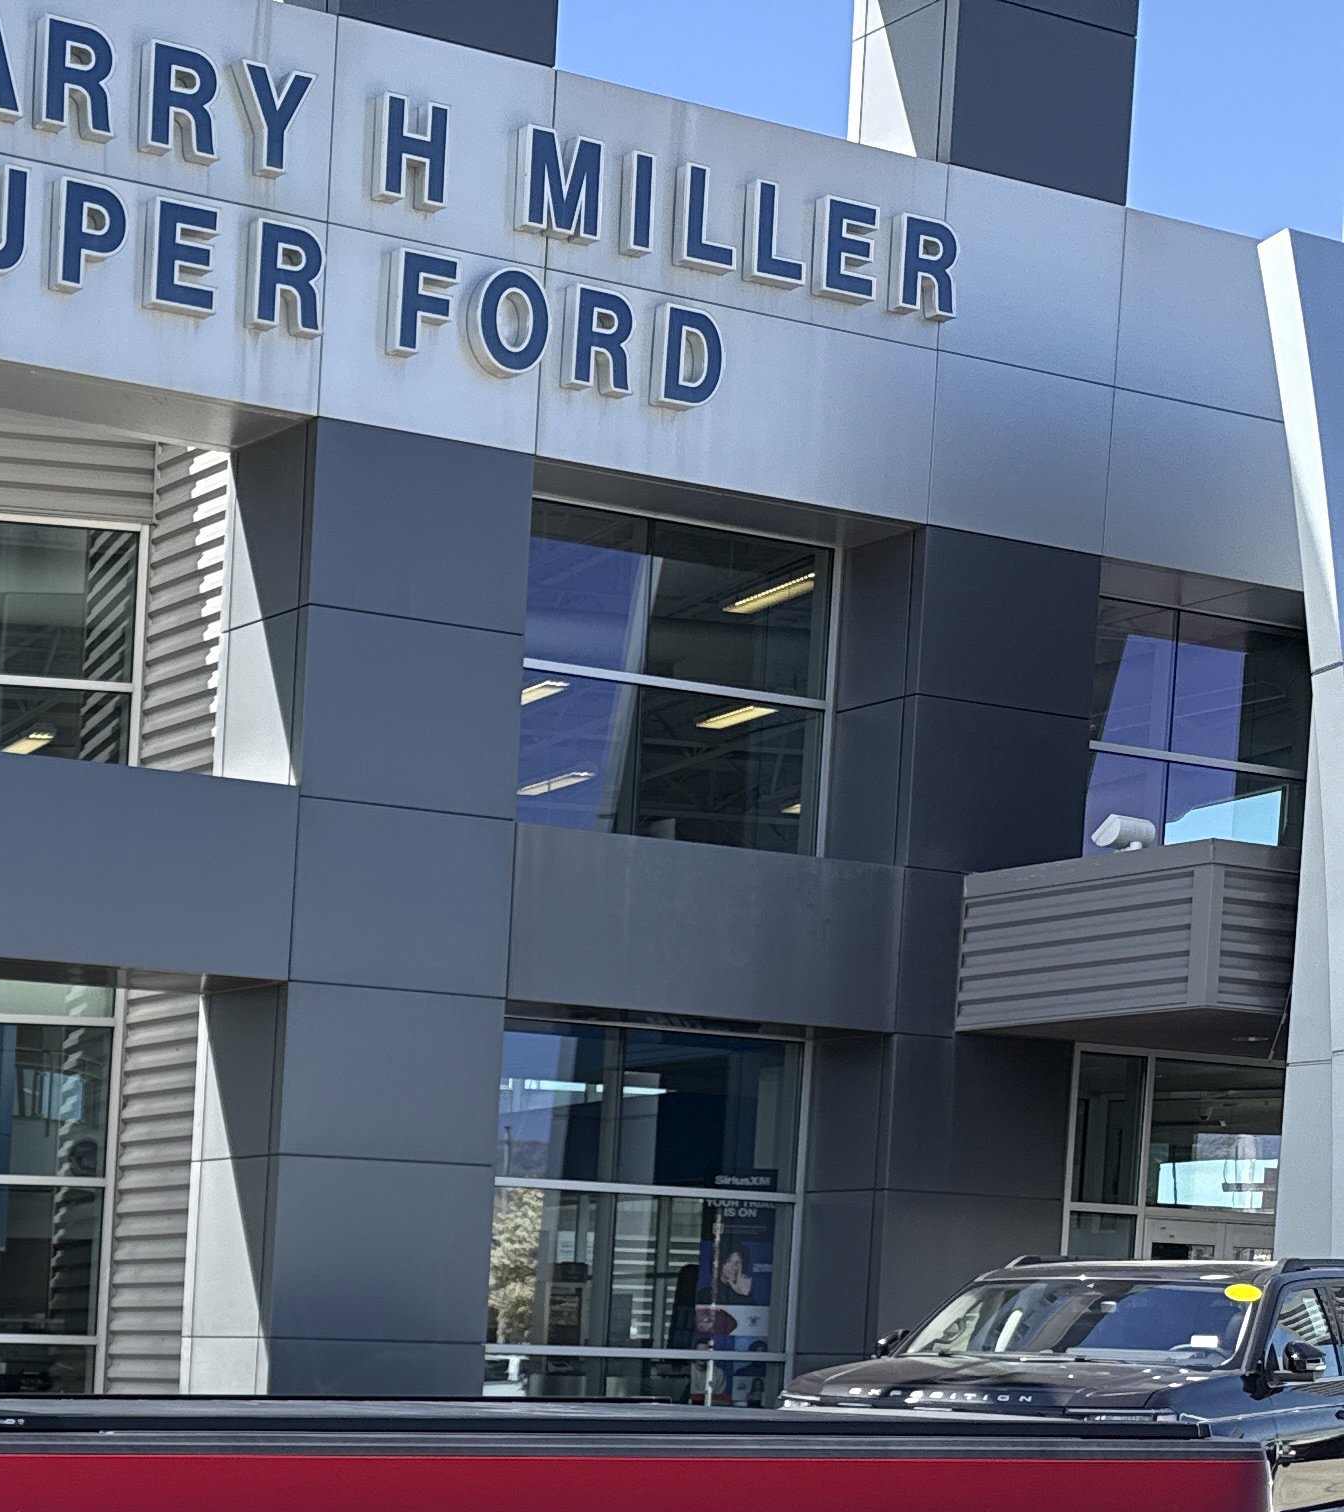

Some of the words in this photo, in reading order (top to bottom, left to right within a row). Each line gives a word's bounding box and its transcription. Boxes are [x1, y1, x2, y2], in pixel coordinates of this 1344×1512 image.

[372, 90, 452, 212] H
[515, 123, 961, 322] MILLER
[387, 247, 724, 412] FORD
[714, 1175, 771, 1186] SiriusXM
[706, 1200, 739, 1208] YOUR
[724, 1207, 736, 1217] IS
[738, 1208, 757, 1218] ON
